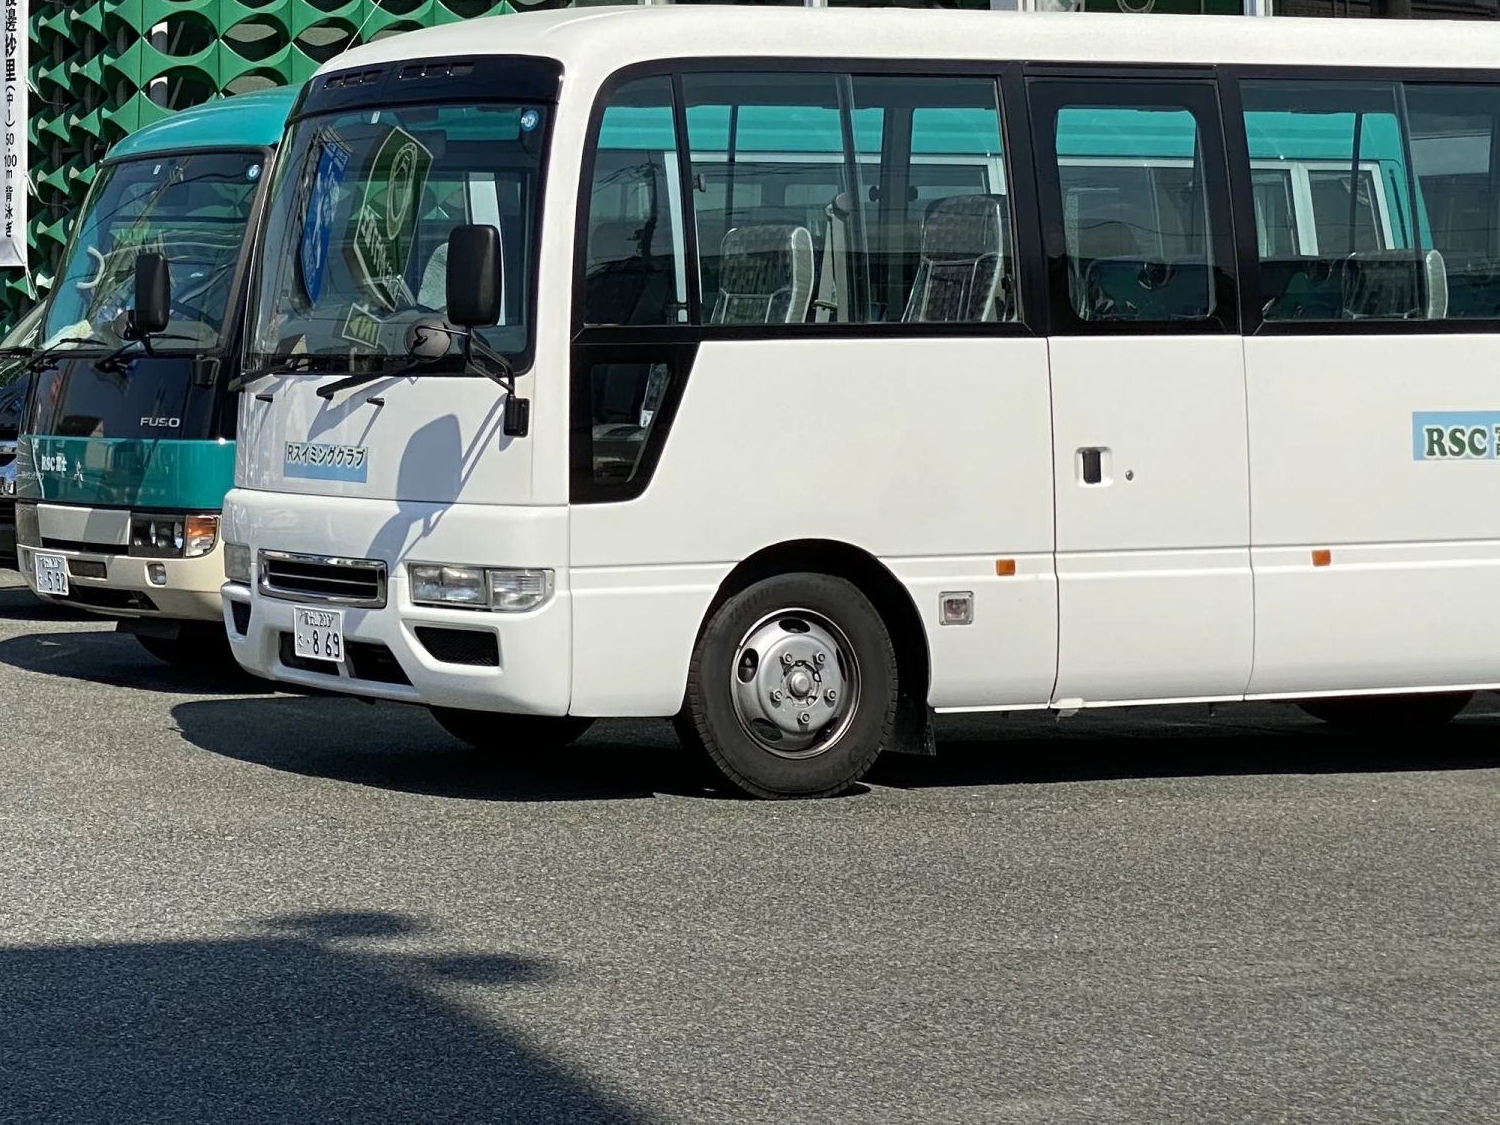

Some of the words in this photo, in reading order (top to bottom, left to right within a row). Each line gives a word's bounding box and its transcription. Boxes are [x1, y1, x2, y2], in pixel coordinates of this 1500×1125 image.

[140, 417, 180, 428] FUSO
[287, 444, 366, 467] Rスイミングクラブ
